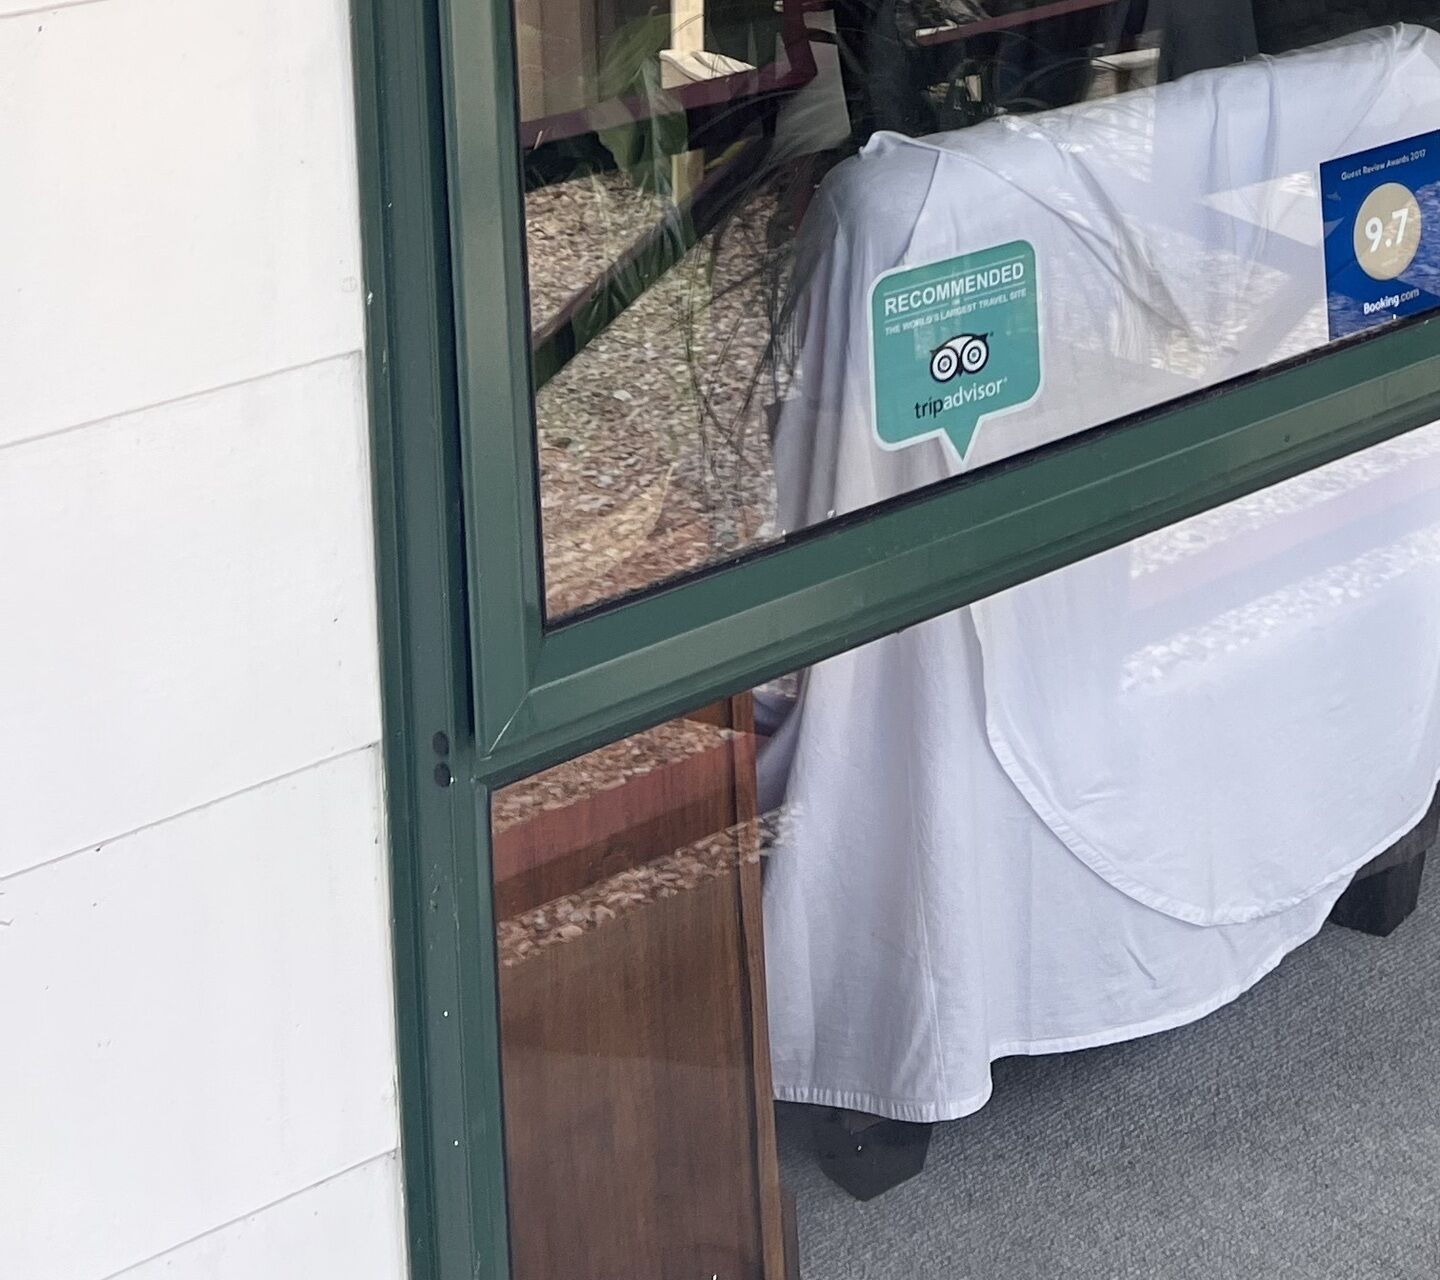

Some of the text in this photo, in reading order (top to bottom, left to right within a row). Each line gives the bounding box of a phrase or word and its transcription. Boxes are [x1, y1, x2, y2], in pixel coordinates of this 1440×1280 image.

[1365, 208, 1409, 253] 9.7
[884, 261, 1024, 317] RECOMMENDED
[1363, 288, 1420, 315] Booking.com
[885, 323, 901, 336] THE
[939, 303, 977, 320] LARGEST
[978, 293, 1009, 309] TRAVEL
[1009, 288, 1027, 301] SITE
[914, 378, 1004, 419] tripadvisor
